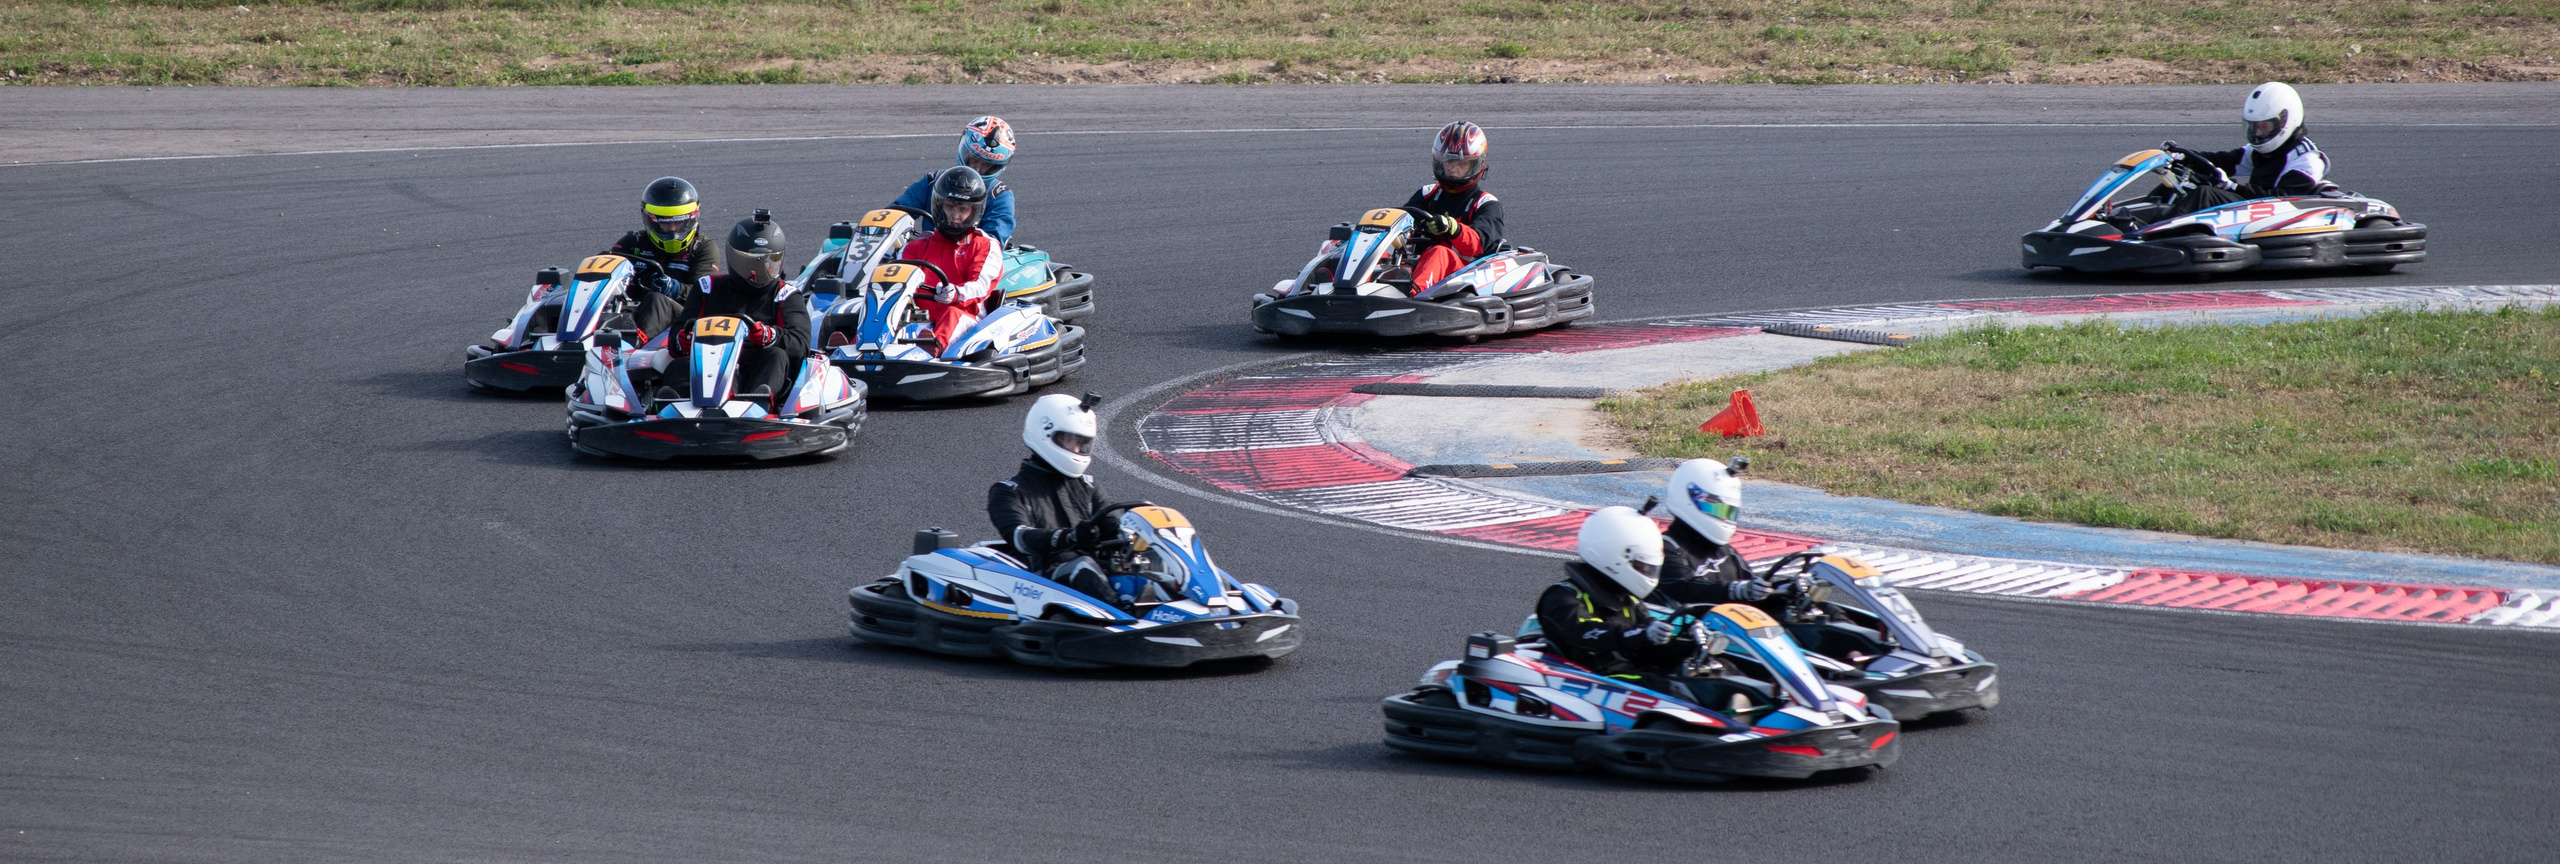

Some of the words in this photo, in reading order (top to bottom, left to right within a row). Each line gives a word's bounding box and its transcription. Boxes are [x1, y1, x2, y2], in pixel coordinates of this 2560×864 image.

[872, 210, 891, 222] 3
[1371, 210, 1391, 221] 6
[849, 243, 873, 261] 3
[586, 256, 617, 270] 17
[883, 265, 902, 278] 9
[703, 318, 731, 332] 14
[1149, 508, 1171, 522] 7
[1012, 581, 1044, 601] Haier
[1151, 609, 1186, 623] Haier
